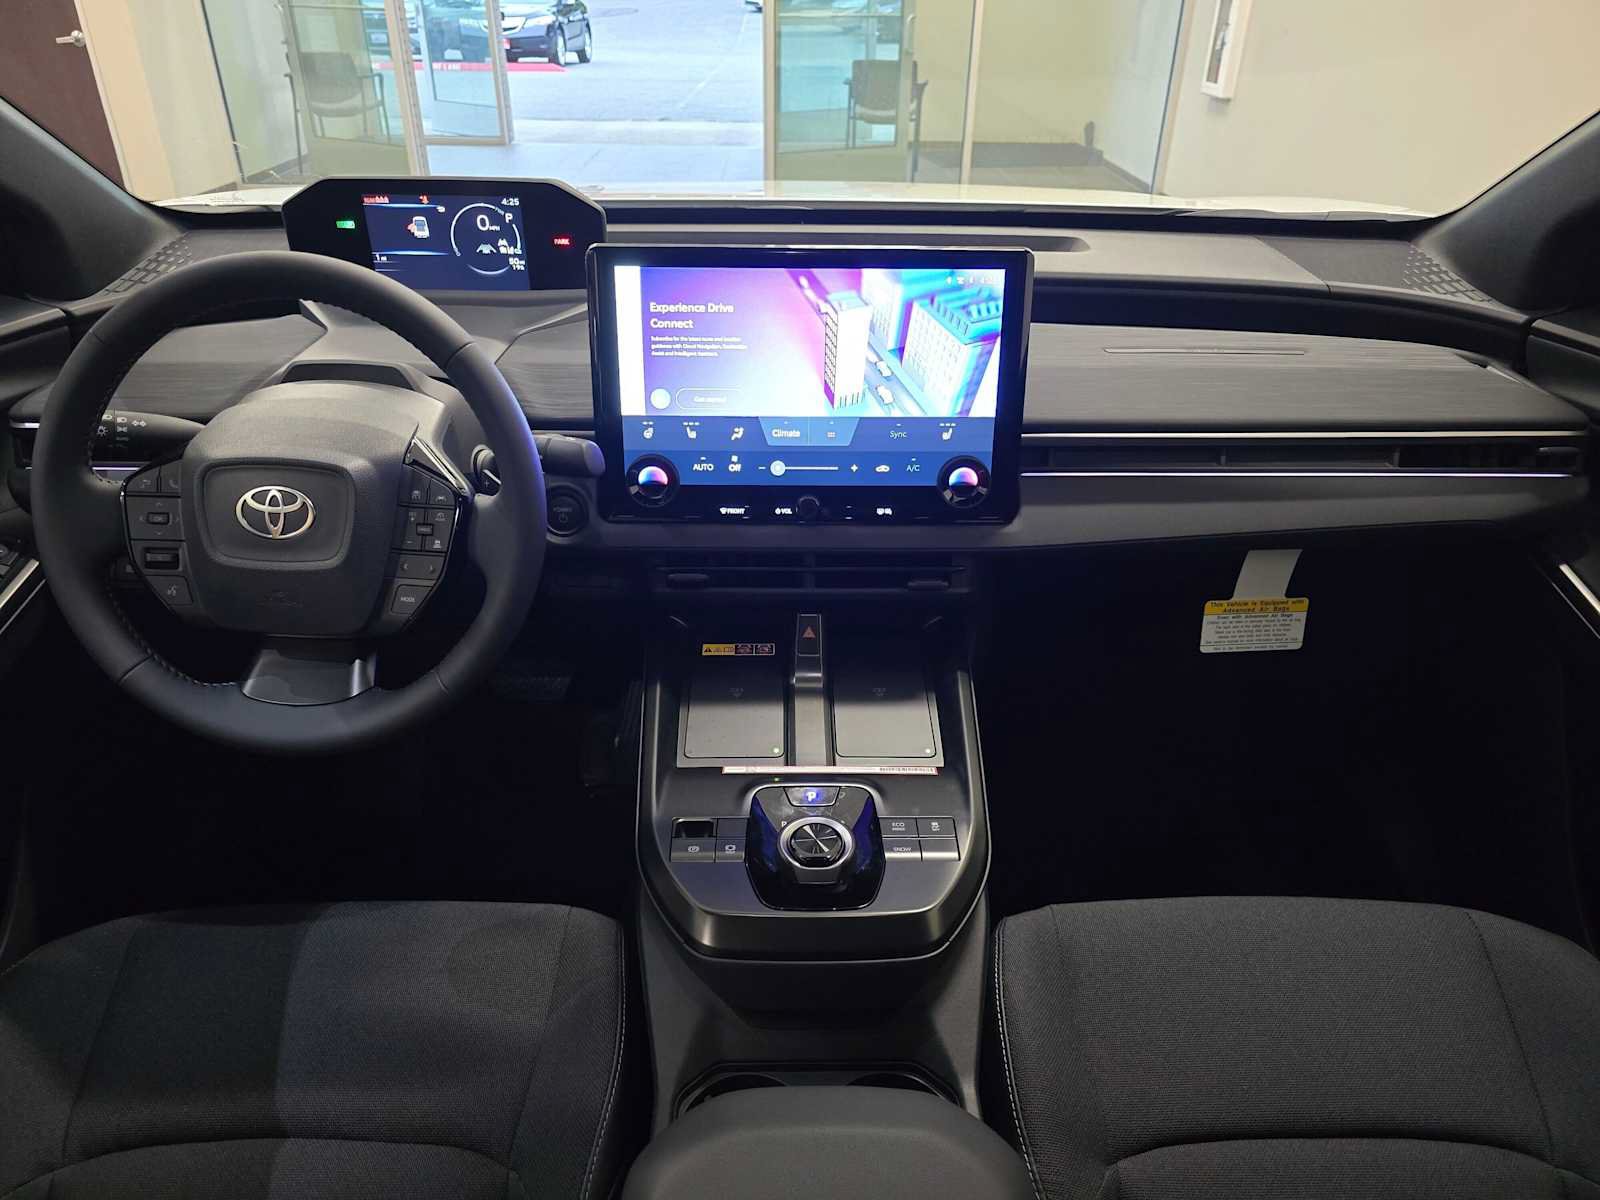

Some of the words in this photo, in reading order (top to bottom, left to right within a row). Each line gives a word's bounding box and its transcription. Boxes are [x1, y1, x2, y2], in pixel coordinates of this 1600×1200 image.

[501, 198, 519, 206] 4:25
[504, 212, 513, 223] P
[476, 214, 490, 231] 0
[650, 302, 706, 314] Experience
[708, 302, 735, 313] Drive
[650, 318, 695, 329] Connect
[771, 429, 801, 438] Climate
[890, 430, 907, 439] Sync
[692, 464, 714, 472] AUTO
[728, 463, 742, 472] Off
[906, 464, 920, 472] A/C
[727, 507, 746, 515] FRONT
[807, 791, 817, 802] P
